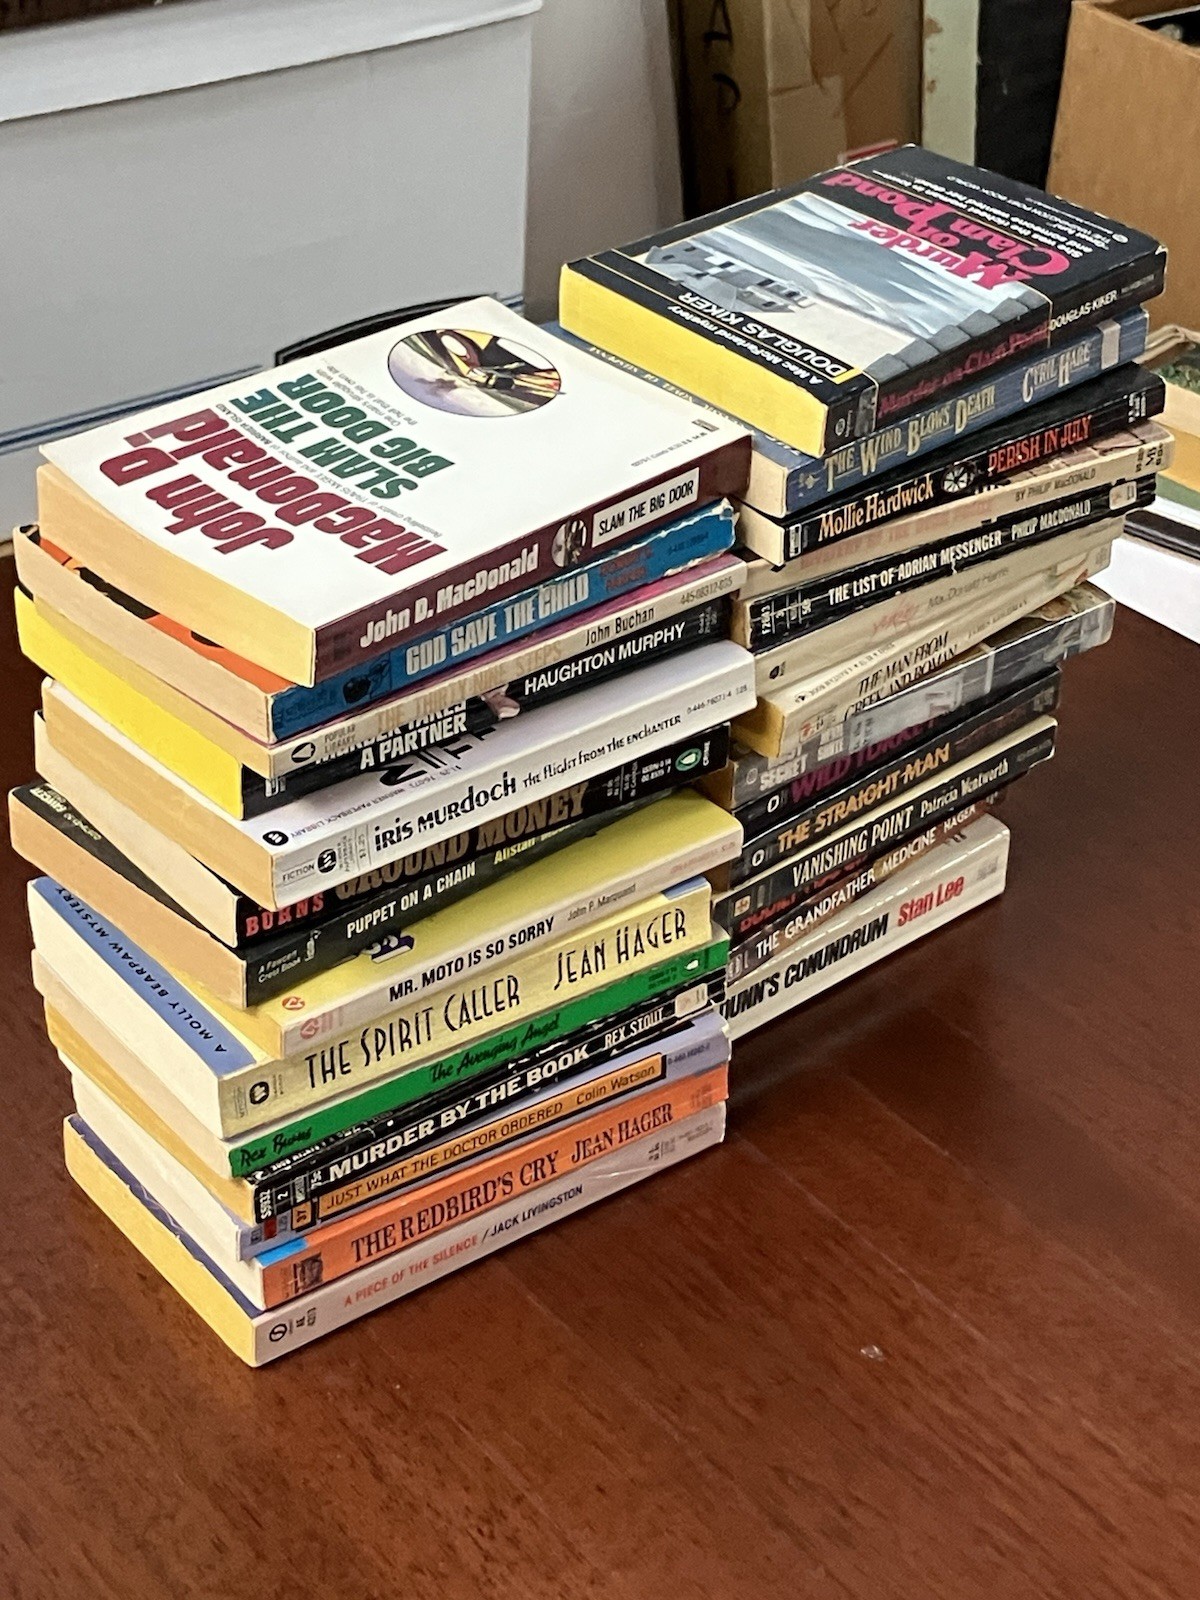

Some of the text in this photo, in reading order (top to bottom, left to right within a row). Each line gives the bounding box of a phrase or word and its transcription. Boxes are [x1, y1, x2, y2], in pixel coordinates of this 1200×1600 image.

[821, 172, 1070, 276] Clam Pond
[847, 219, 1033, 291] Murder
[907, 223, 960, 247] on
[1010, 220, 1031, 237] the
[1012, 216, 1067, 242] someone
[1031, 232, 1056, 247] was
[1057, 243, 1083, 258] She
[1066, 238, 1093, 253] and
[667, 305, 823, 385] A Mac McFarland mystery
[678, 292, 848, 377] DOUGLAS KIKER
[215, 403, 243, 424] ISLAND
[229, 388, 419, 500] SLAM THE
[240, 423, 272, 445] BARRIER
[276, 373, 456, 479] BIG DOOR
[824, 340, 1090, 492] THE WIND BLOWS DEATH CYRIL HARE
[99, 431, 295, 555] John D.
[146, 408, 449, 576] MacDonald
[818, 504, 864, 542] Mollie
[864, 473, 934, 524] Hardwick
[988, 436, 1042, 477] PERISH
[1043, 428, 1060, 453] IN
[1060, 414, 1092, 448] JULY
[1016, 481, 1052, 502] BY PHILIP
[360, 480, 695, 648] John D. MacDonald SLAM THE BIG DOOR
[829, 499, 1091, 606] THE LIST OF ADRIAN MESSENGER PHILIP MACDONALD
[406, 573, 590, 676] GOD SAVE THE CHILD
[524, 621, 687, 696] HAUGHTON MURPHY
[586, 606, 656, 646] John Buchan
[858, 668, 882, 698] THE
[886, 653, 914, 683] MAN
[914, 631, 949, 666] FROM
[360, 747, 376, 771] A
[379, 712, 468, 763] PARTNER
[791, 757, 850, 803] WILD
[476, 781, 590, 851] MONEY
[778, 742, 950, 853] THE STRAIGHT MAN
[792, 758, 1009, 888] VANISHING POINT Patricia Wentworth
[283, 861, 316, 882] FICTION
[347, 836, 536, 939] PUPPET ON A CHAIN Alistair
[756, 931, 781, 960] THE
[785, 868, 877, 939] GRANDFATHER
[882, 826, 938, 875] MEDICINE
[943, 804, 977, 834] HAGER
[55, 886, 227, 1053] A MOLLY BEARPAW MYSTERY
[389, 884, 636, 1002] MR. MOTO IS SO SORRY John P. Marquand
[785, 913, 890, 989] CONUNDRUM
[897, 890, 934, 927] Stan
[937, 875, 965, 911] Lee
[304, 907, 687, 1089] THE SPIRIT CALLER JEAN HAGER
[240, 1148, 267, 1167] Rex
[271, 1127, 313, 1152] Burns
[429, 1062, 455, 1083] The
[457, 1039, 518, 1075] Avenging
[523, 1012, 561, 1045] Angel
[325, 1063, 656, 1211] JUST WHAT THE DOCTOR ORDERED Colin Watson
[329, 1111, 435, 1184] MURDER
[440, 1094, 472, 1130] BY
[475, 1072, 524, 1111] THE
[526, 1044, 591, 1088] BOOK
[604, 1023, 627, 1049] REX
[629, 1006, 666, 1037] STOUT
[351, 1222, 397, 1264] THE
[400, 1171, 514, 1241] REDBIRD'S
[519, 1150, 560, 1188] CRY
[571, 1127, 614, 1165] JEAN
[617, 1102, 674, 1144] HAGER
[344, 1184, 584, 1308] A PIECE OF THE SILENCE JACK LIVINGSTON
